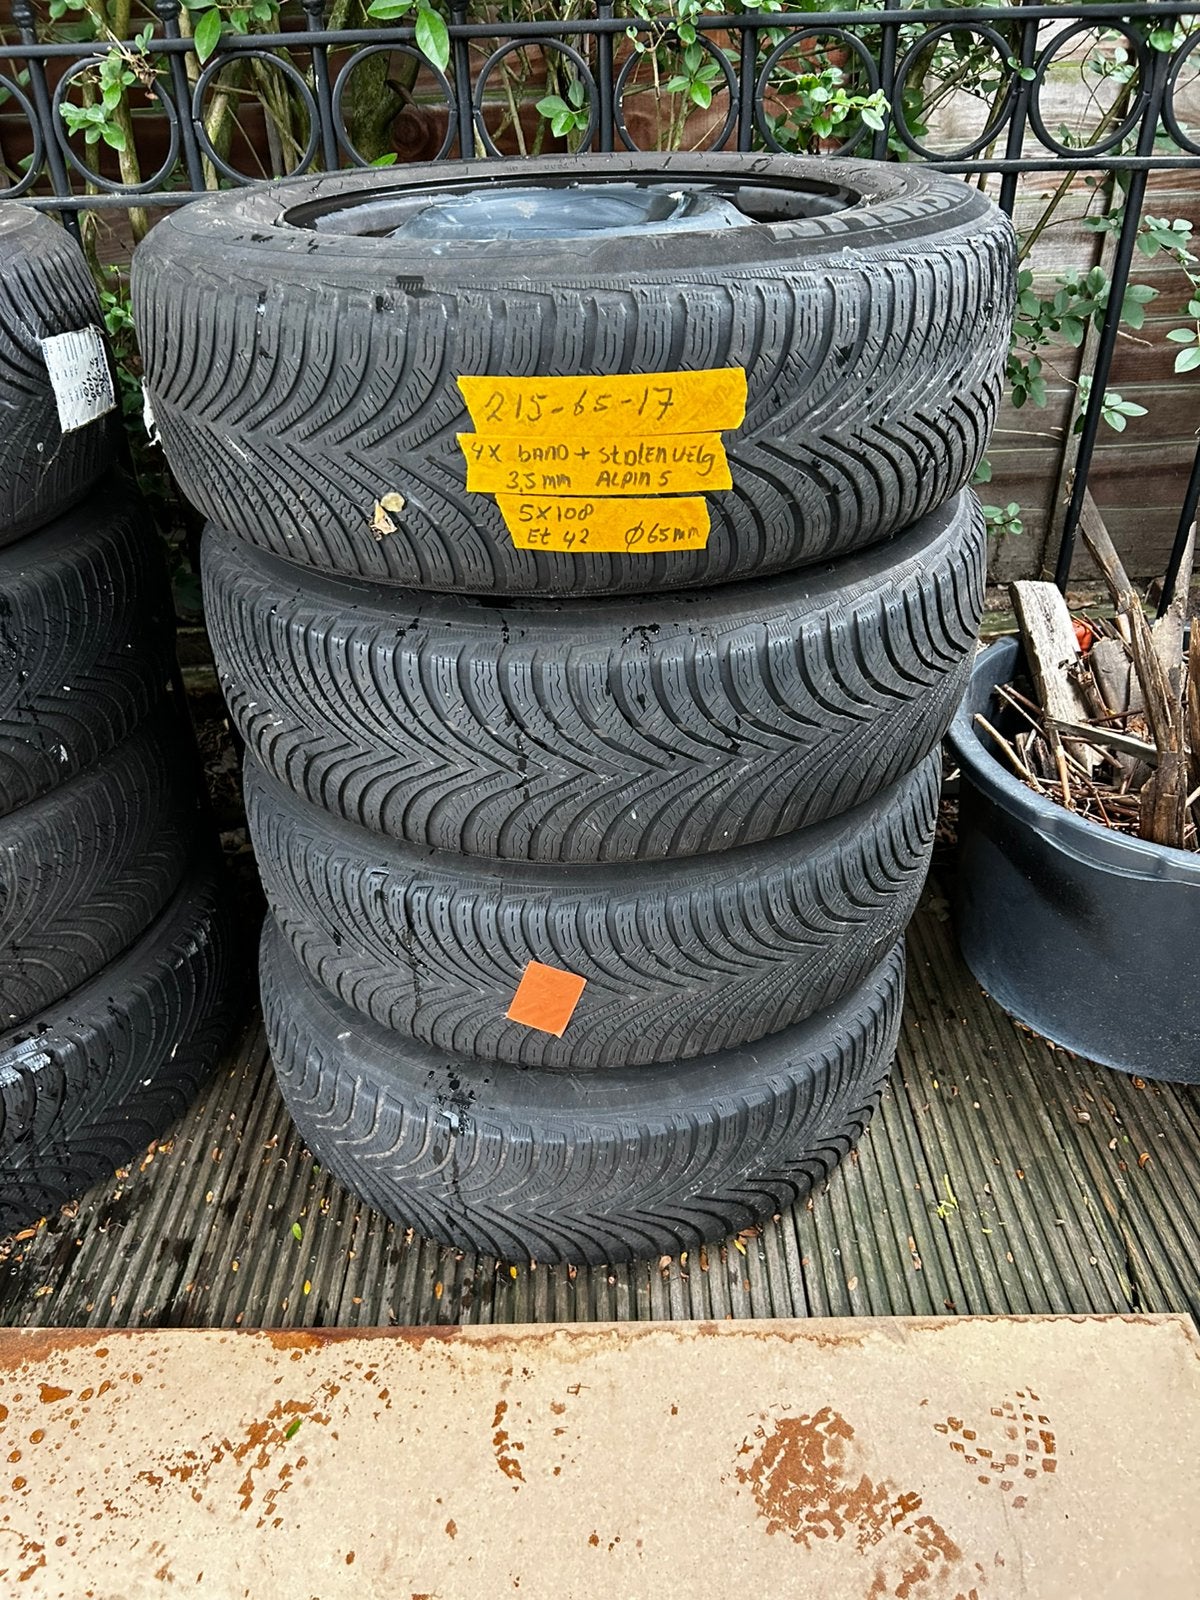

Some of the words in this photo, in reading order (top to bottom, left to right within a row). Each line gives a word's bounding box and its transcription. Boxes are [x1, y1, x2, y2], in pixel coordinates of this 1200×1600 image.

[766, 183, 968, 240] MICHELIN
[485, 387, 674, 421] 215-65-17
[562, 528, 590, 549] 42
